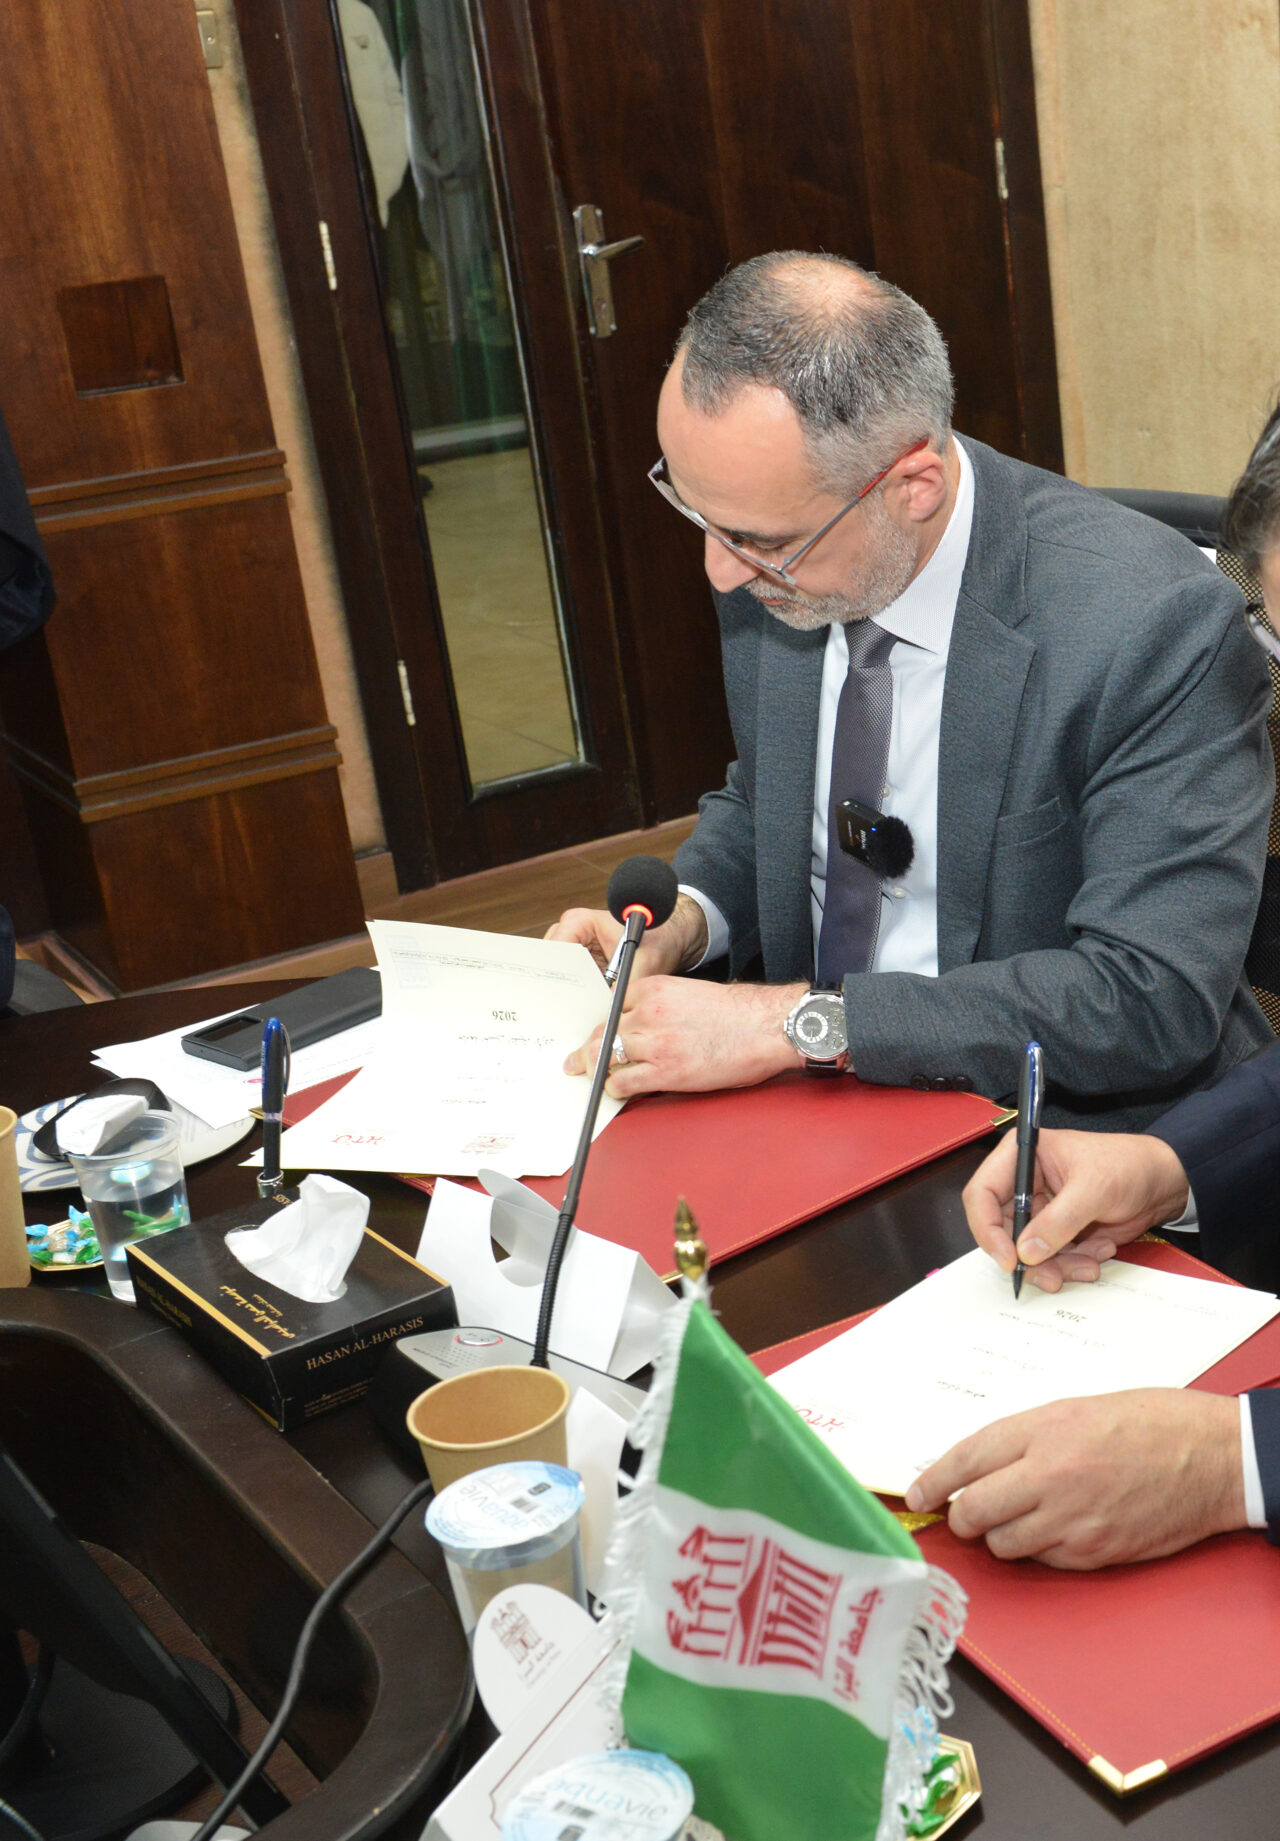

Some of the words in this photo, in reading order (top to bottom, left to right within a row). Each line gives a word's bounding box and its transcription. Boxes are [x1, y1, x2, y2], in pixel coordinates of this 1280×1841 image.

[306, 1343, 351, 1370] HASAN
[353, 1316, 424, 1353] AL-HARASIS
[839, 1586, 884, 1657] جامعة
